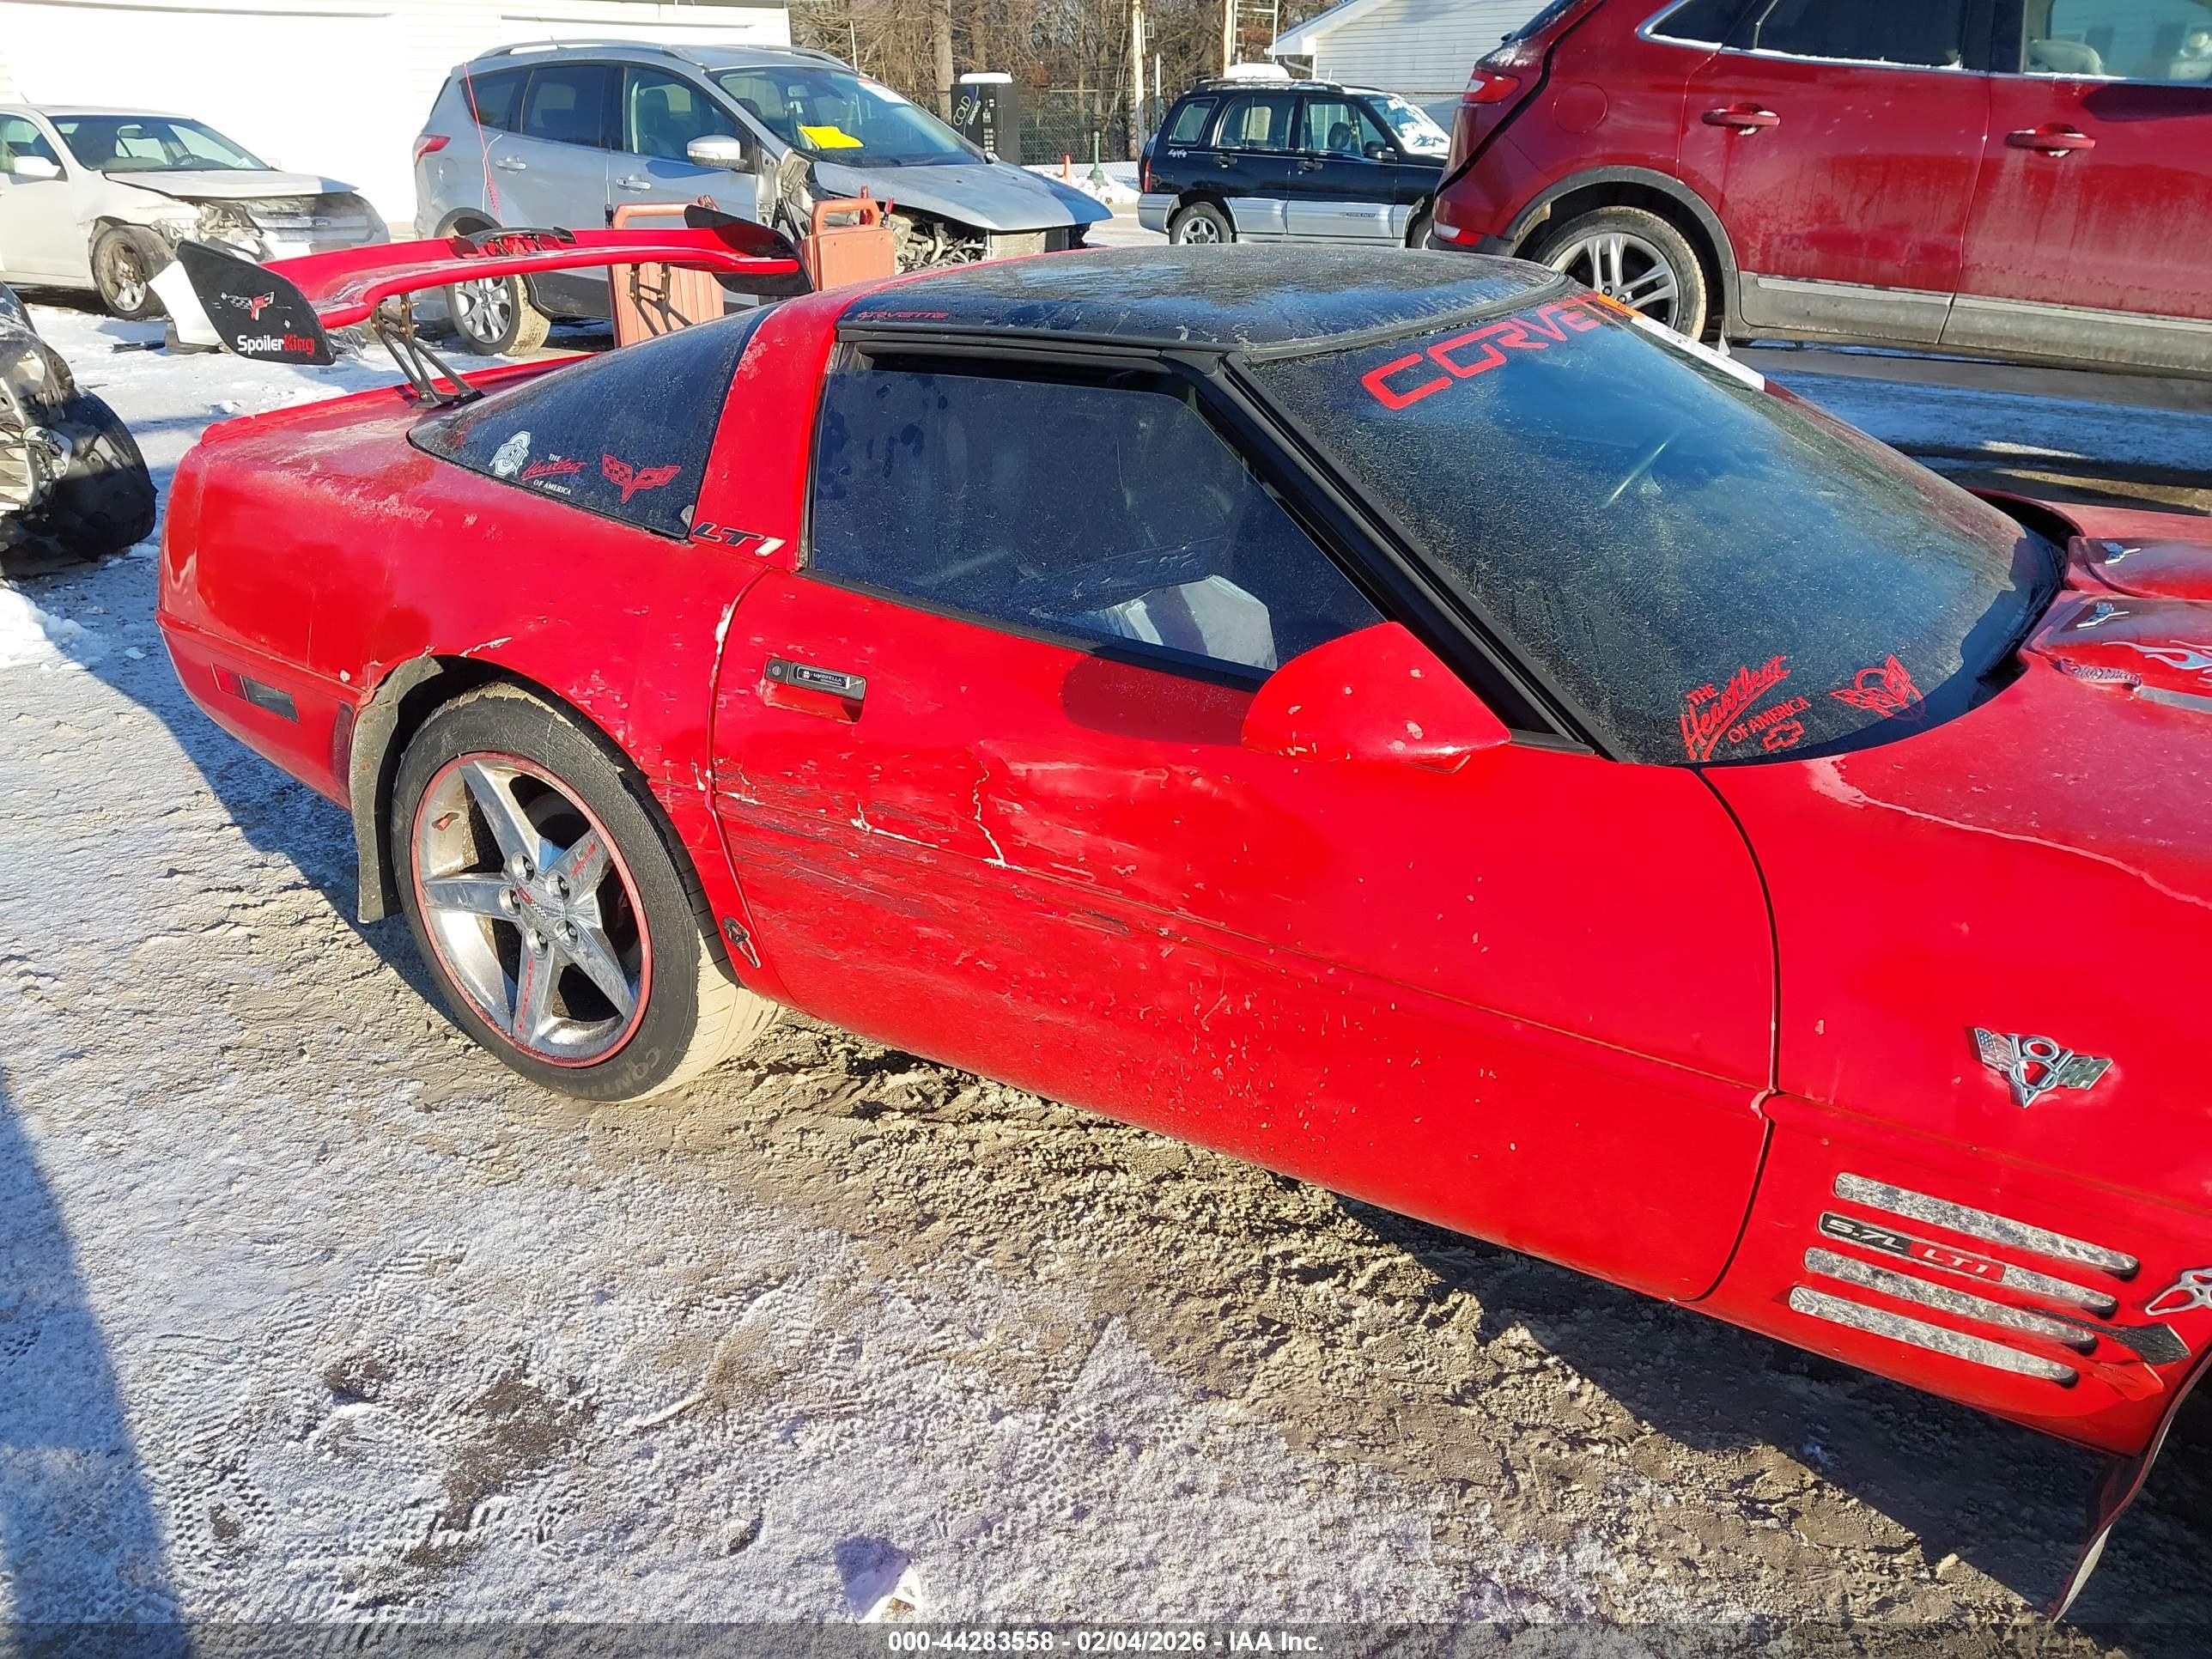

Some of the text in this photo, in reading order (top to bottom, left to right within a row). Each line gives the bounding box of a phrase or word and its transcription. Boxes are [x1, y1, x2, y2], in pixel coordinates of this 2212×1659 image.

[953, 95, 971, 126] COLD
[548, 453, 562, 462] THE
[543, 482, 571, 495] AMERICA
[689, 521, 787, 557] LT1
[1686, 684, 1718, 706] THE
[1728, 696, 1812, 744] OF AMERICA
[1826, 1218, 1989, 1274] 5.7L LT1
